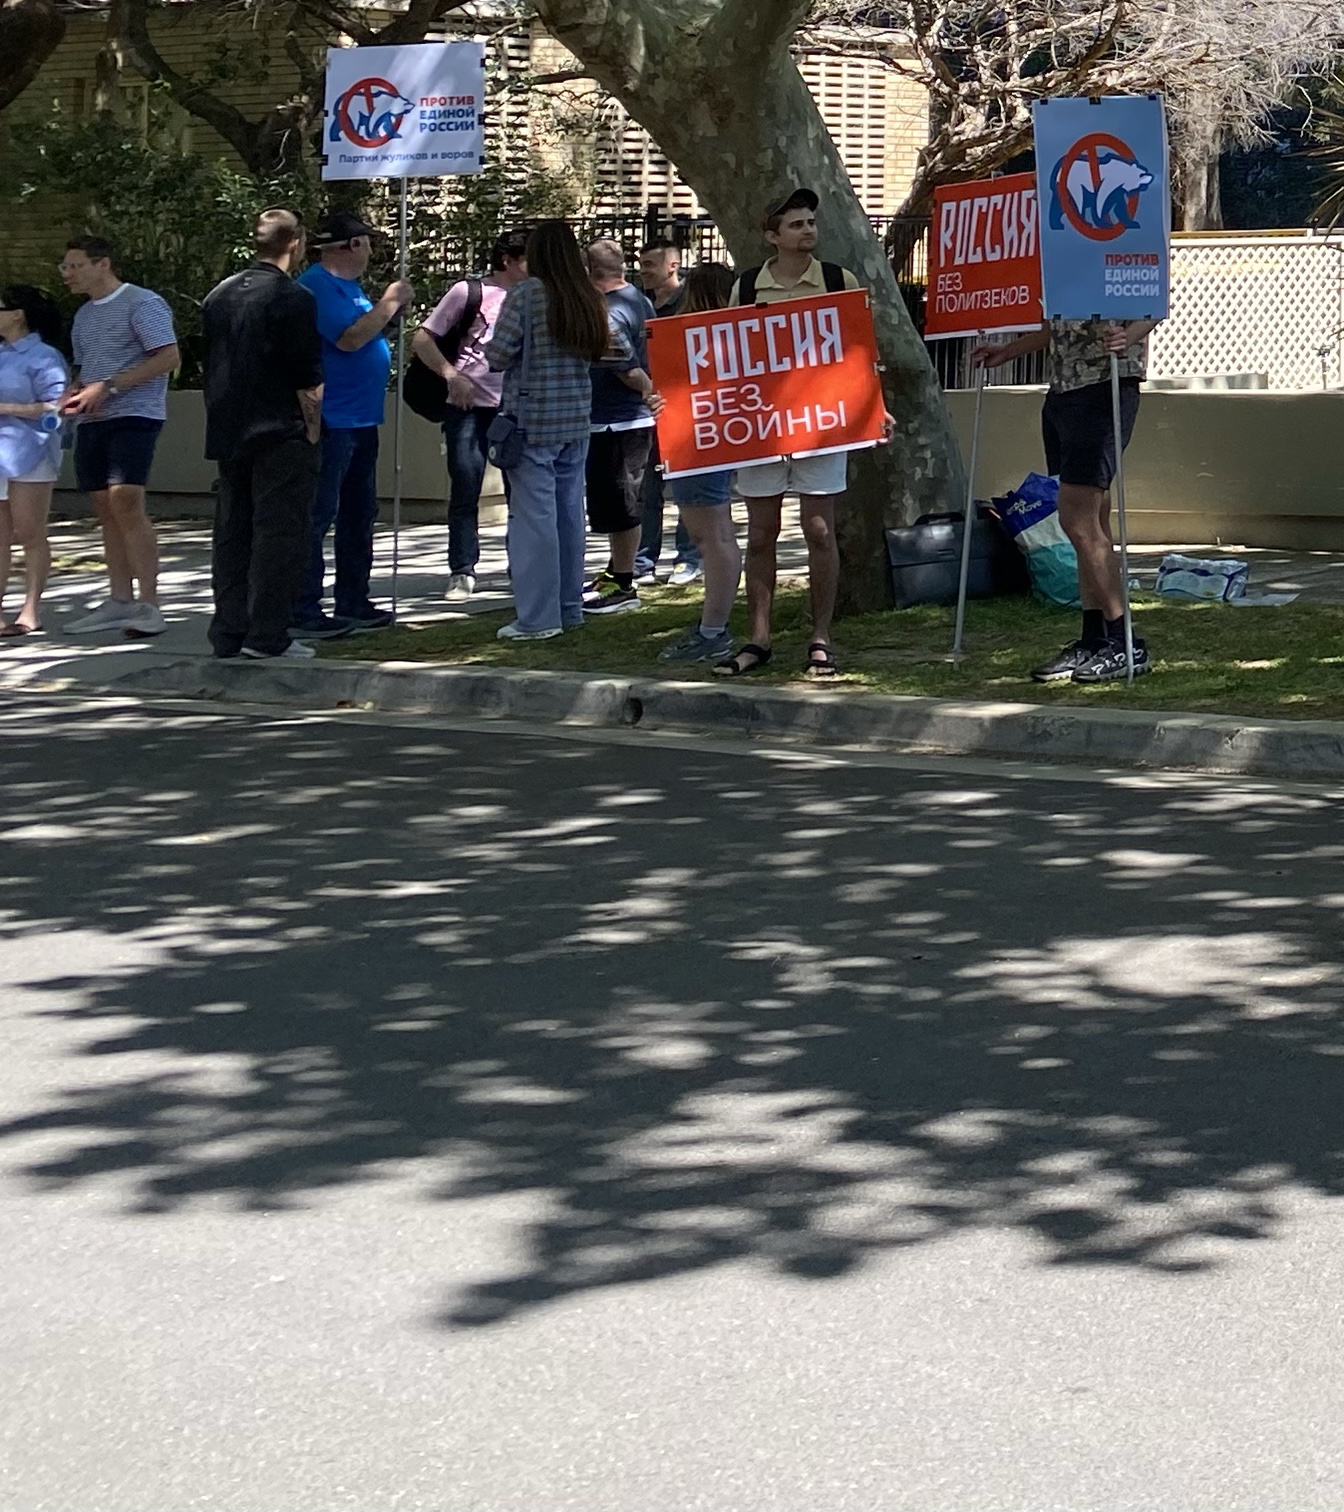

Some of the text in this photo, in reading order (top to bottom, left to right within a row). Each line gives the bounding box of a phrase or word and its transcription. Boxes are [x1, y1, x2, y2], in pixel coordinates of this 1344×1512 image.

[419, 95, 475, 107] ПРОТИВ
[419, 107, 475, 120] ЕДИНОЙ
[419, 121, 475, 133] РОССИИ
[338, 153, 379, 164] Партии
[431, 152, 438, 160] и
[440, 150, 475, 161] воров
[939, 188, 1039, 268] РОССИЯ
[1104, 253, 1159, 266] ПРОТИВ
[936, 271, 963, 293] БЕЗ
[1104, 266, 1159, 282] ЕДИНОЙ
[1104, 284, 1159, 297] РОССИИ
[935, 285, 1030, 314] ПОЛИТЗЕКОВ
[684, 306, 844, 385] РОССИЯ
[690, 383, 762, 420] БЕЗ
[694, 400, 847, 451] ВОЙНЫ
